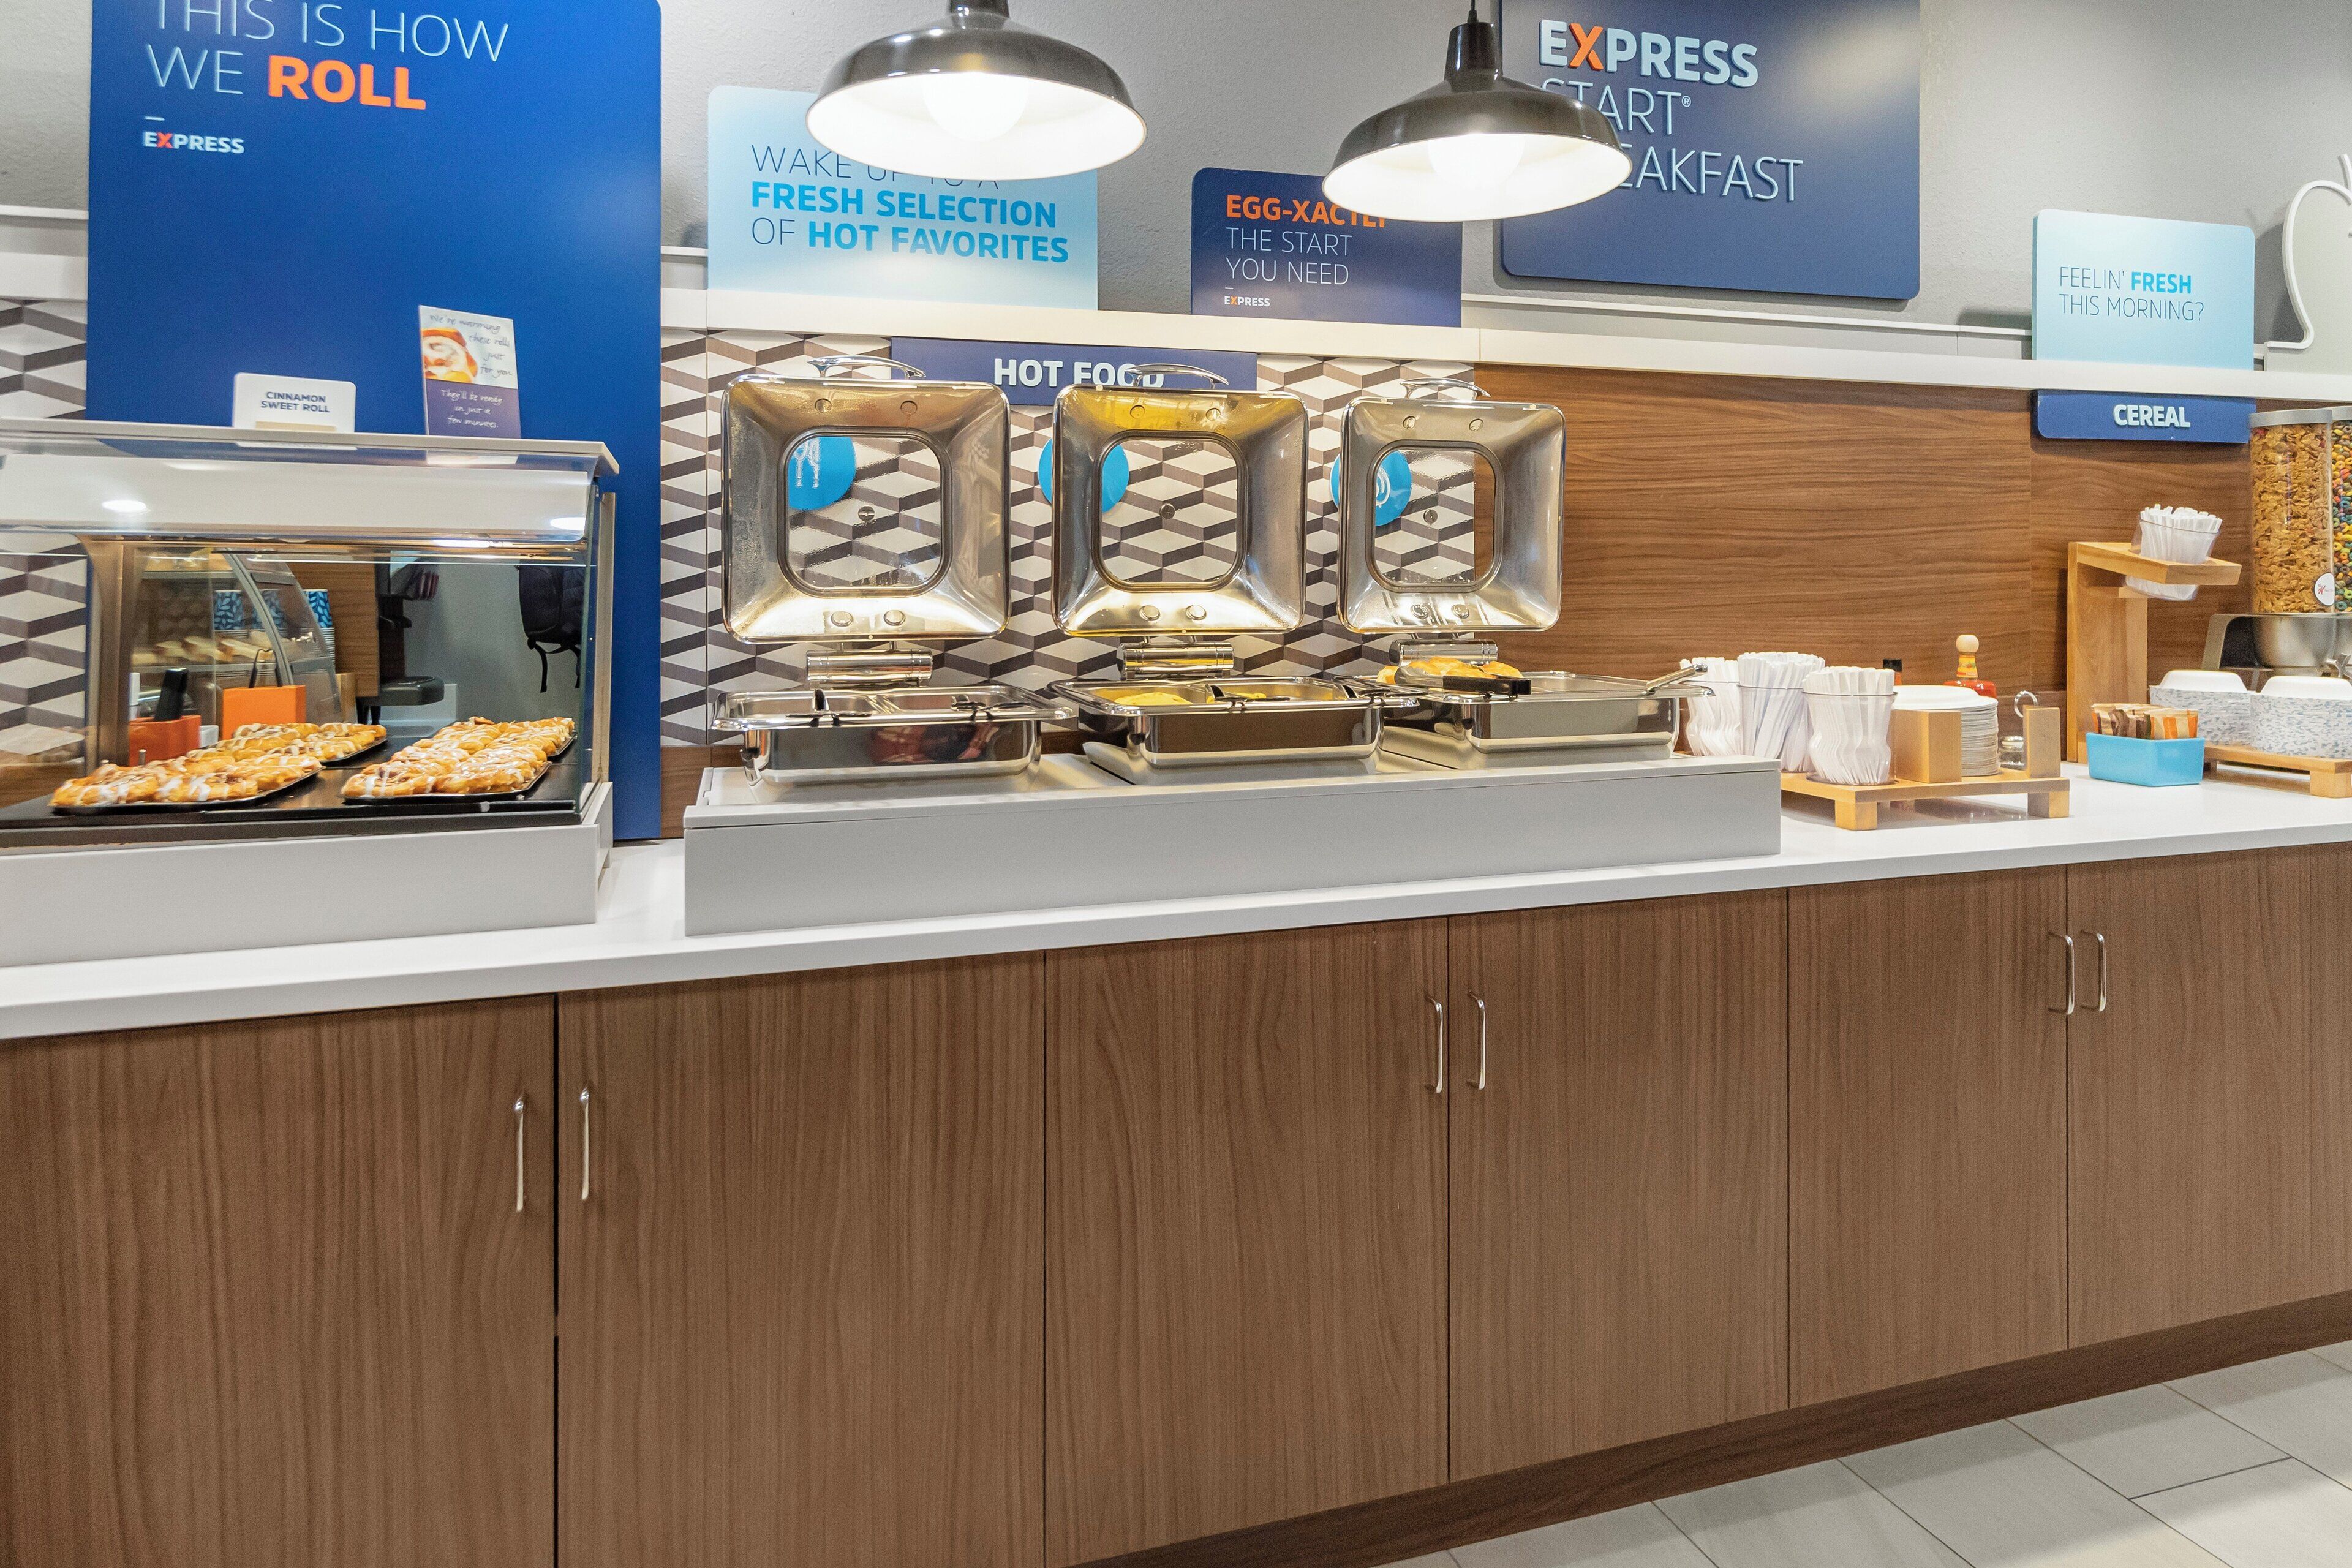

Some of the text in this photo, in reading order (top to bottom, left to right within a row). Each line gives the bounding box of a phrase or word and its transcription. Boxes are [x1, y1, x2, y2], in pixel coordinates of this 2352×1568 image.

[302, 2, 345, 47] IS
[371, 9, 509, 62] HOW
[1539, 18, 1759, 88] EXPRESS
[146, 43, 426, 110] WE ROLL
[143, 130, 245, 154] EXPRESS
[752, 145, 851, 178] WAKE
[1617, 143, 1804, 202] AKFAST
[752, 181, 1056, 228] FRESH SELECTION
[752, 217, 1068, 263] OF HOT FAVORITES
[1226, 227, 1352, 256] THE START
[1226, 257, 1349, 285] YOU NEED
[2059, 266, 2192, 294] FEELIN' FRESH
[1224, 295, 1270, 307] EXPRESS
[2059, 293, 2204, 322] THIS MORNING?
[469, 332, 491, 344] these
[483, 352, 505, 362] just
[994, 358, 1063, 388] HOT
[261, 401, 330, 413] SWEET ROLL
[266, 391, 326, 403] CINNAMON
[470, 391, 479, 401] be
[480, 394, 504, 406] ready
[447, 415, 462, 424] few
[2113, 404, 2191, 428] CEREAL
